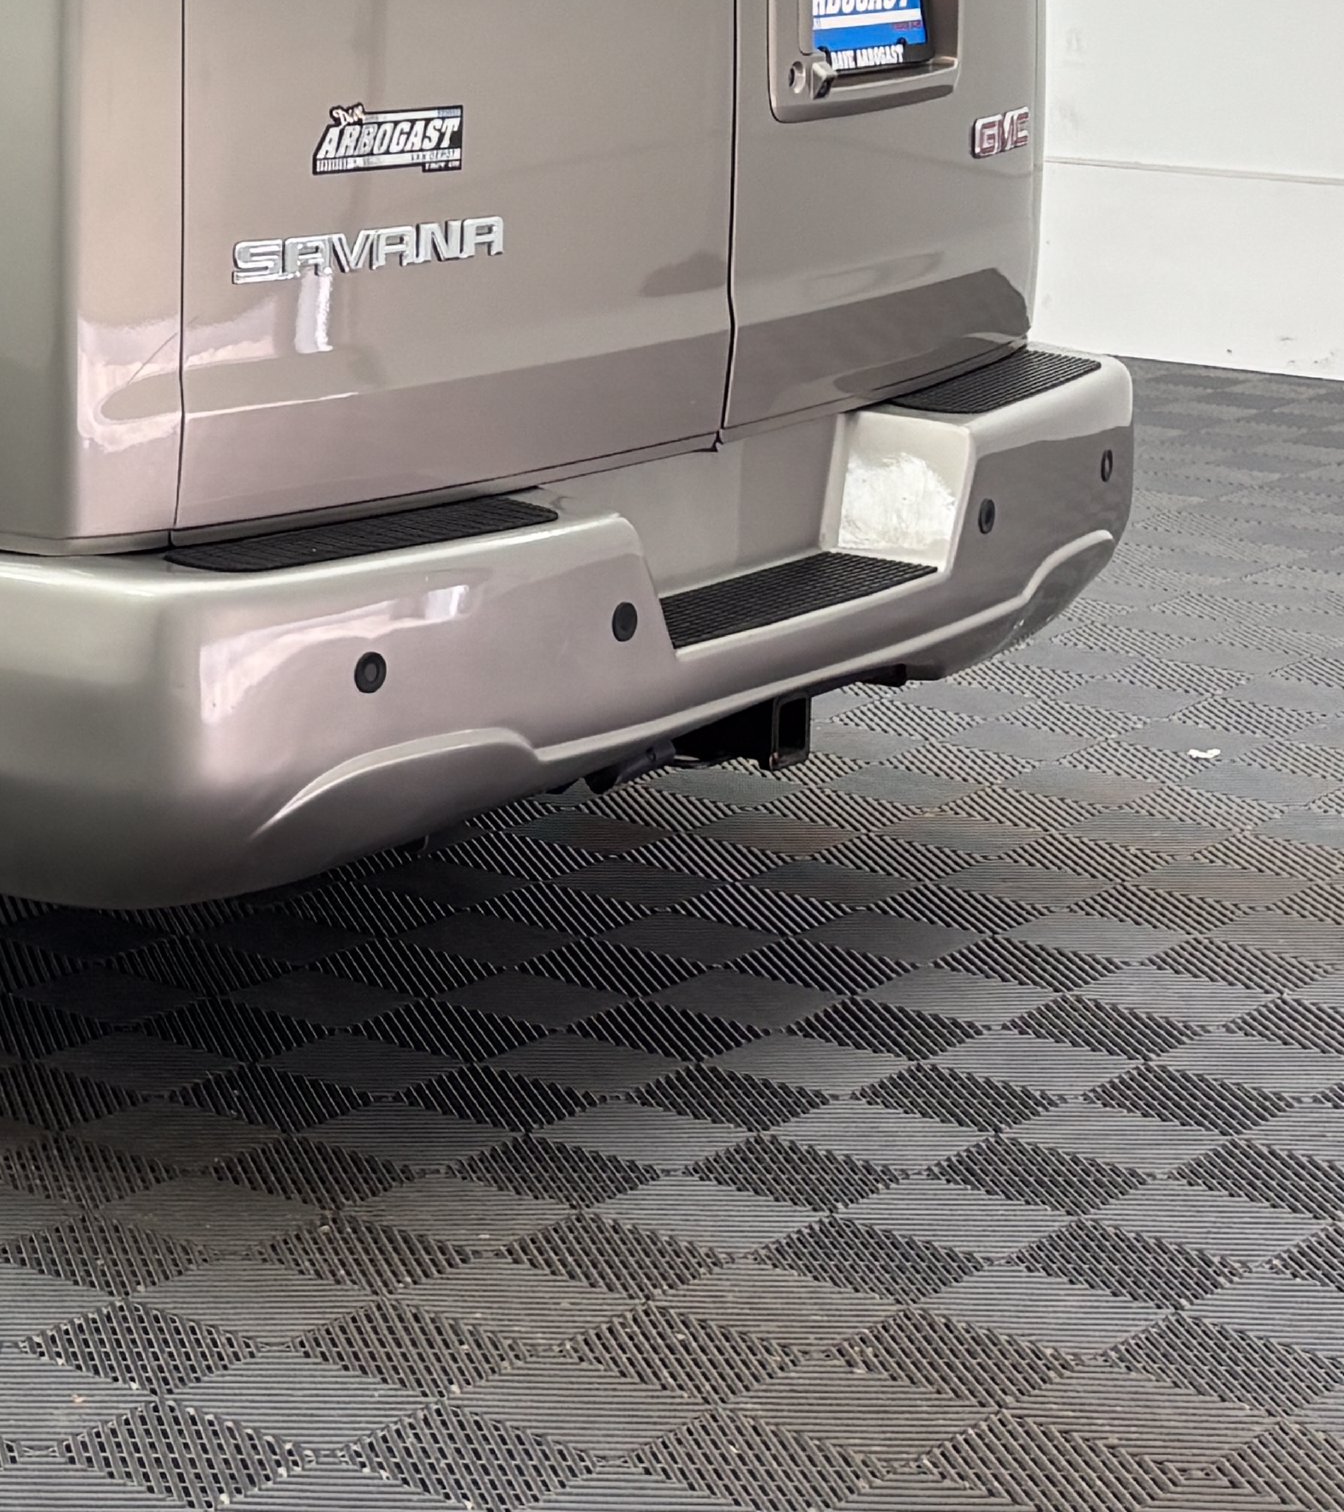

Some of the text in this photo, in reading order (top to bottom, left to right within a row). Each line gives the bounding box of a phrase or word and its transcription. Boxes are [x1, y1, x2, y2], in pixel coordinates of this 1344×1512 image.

[316, 117, 460, 159] ARBOGAST
[971, 105, 1029, 159] GMC
[232, 216, 504, 284] SAVANA
